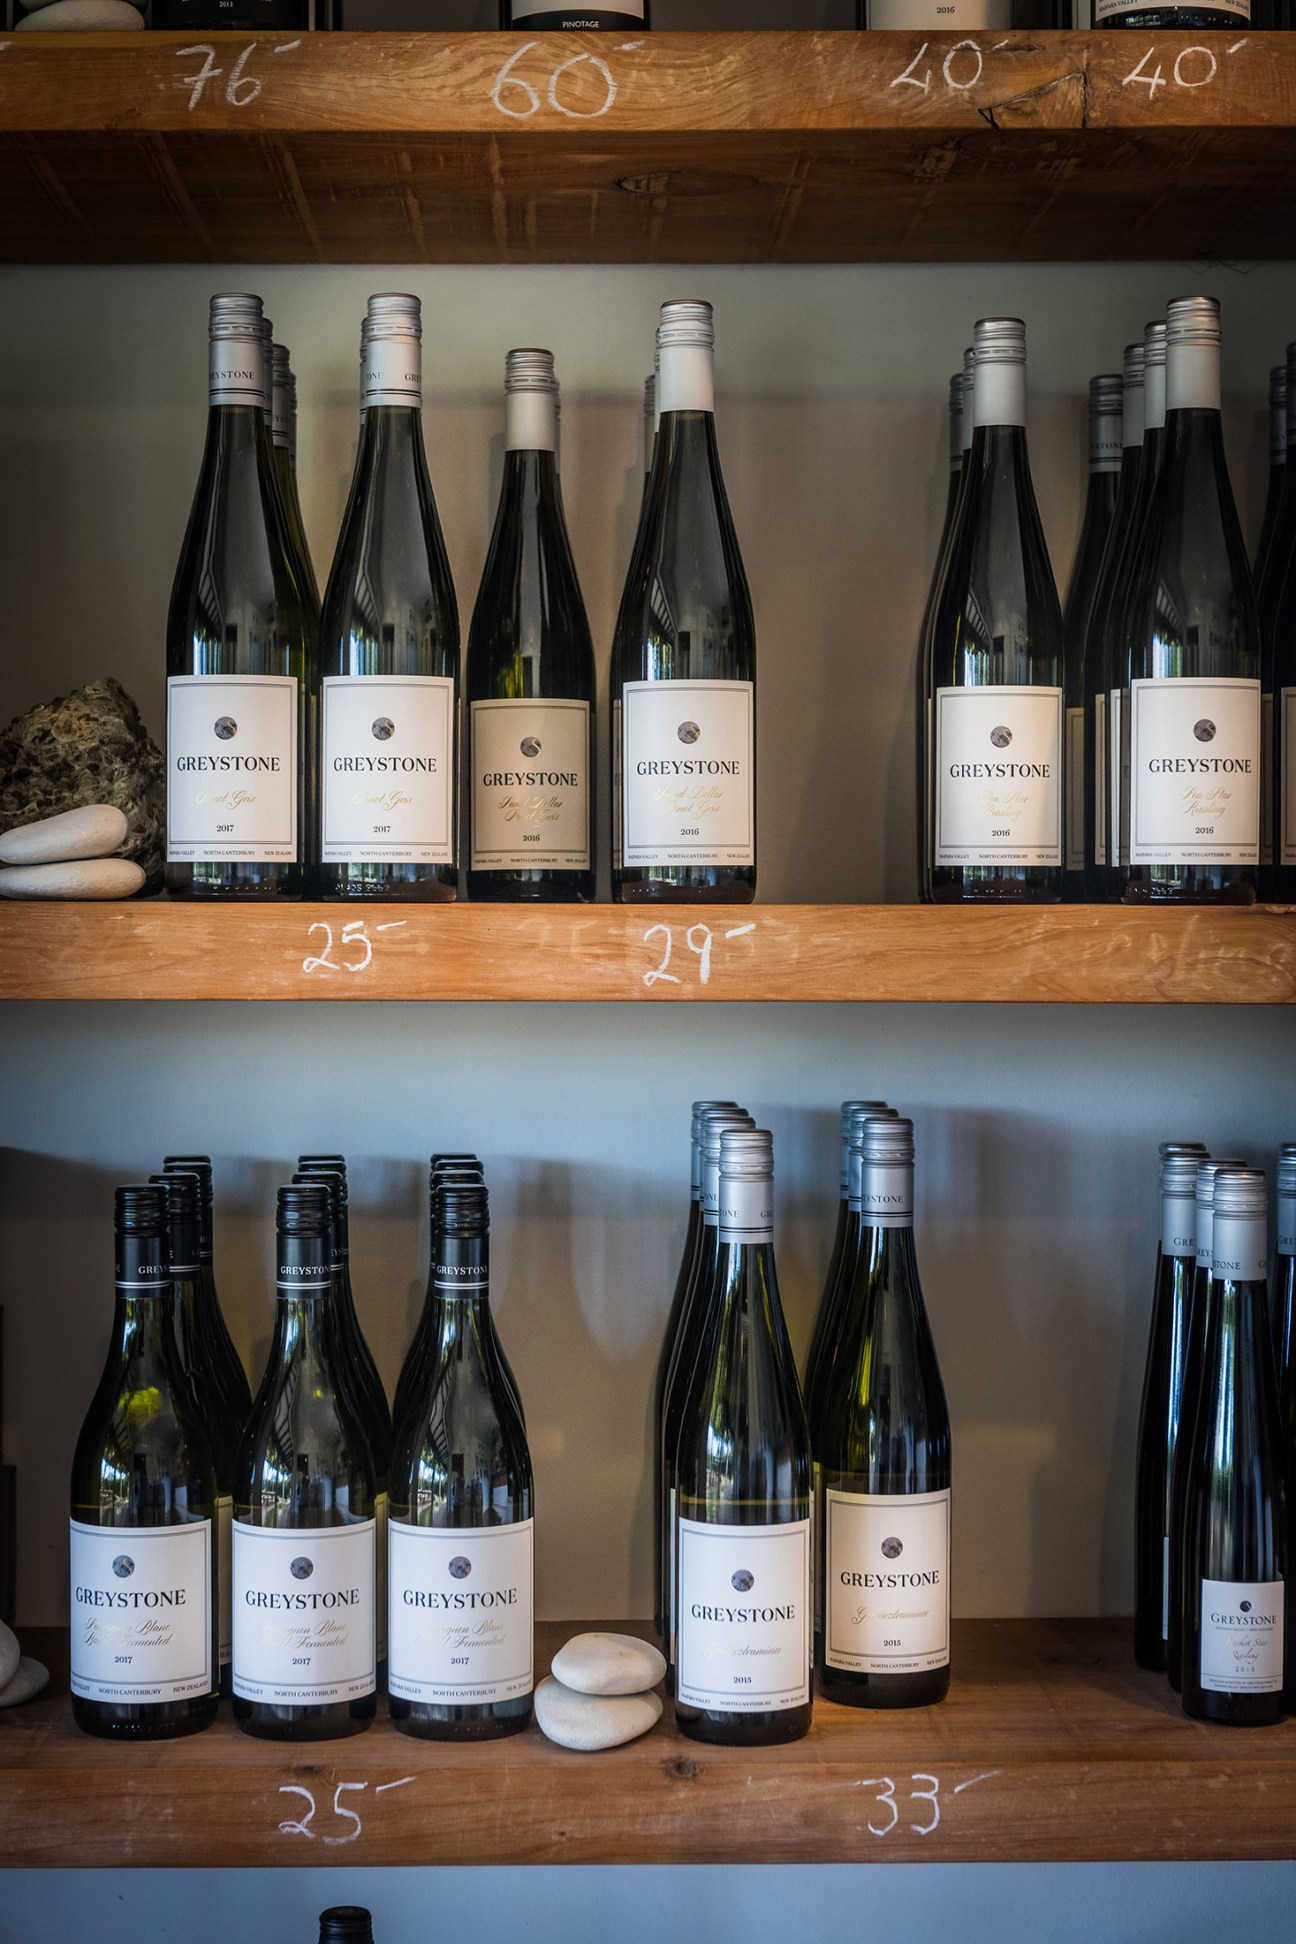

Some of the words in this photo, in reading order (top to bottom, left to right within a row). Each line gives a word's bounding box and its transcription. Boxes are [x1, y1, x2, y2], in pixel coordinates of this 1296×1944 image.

[936, 6, 955, 14] 2016
[177, 756, 280, 771] GREYSTONE
[334, 757, 437, 772] GREYSTONE
[637, 761, 740, 775] GREYSTONE
[1149, 759, 1251, 773] GREYSTONE
[950, 764, 1050, 778] GREYSTONE
[483, 773, 578, 786] GREYSTONE
[841, 1571, 939, 1588] GREYSTONE
[76, 1587, 186, 1608] GREYSTONE
[246, 1589, 359, 1609] GREYSTONE
[403, 1588, 517, 1609] GREYSTONE
[692, 1604, 795, 1623] GREYSTONE
[1211, 1613, 1277, 1625] GREYSTONE
[135, 1619, 170, 1636] Blanc
[114, 1656, 133, 1664] 2017
[451, 1657, 469, 1665] 2017
